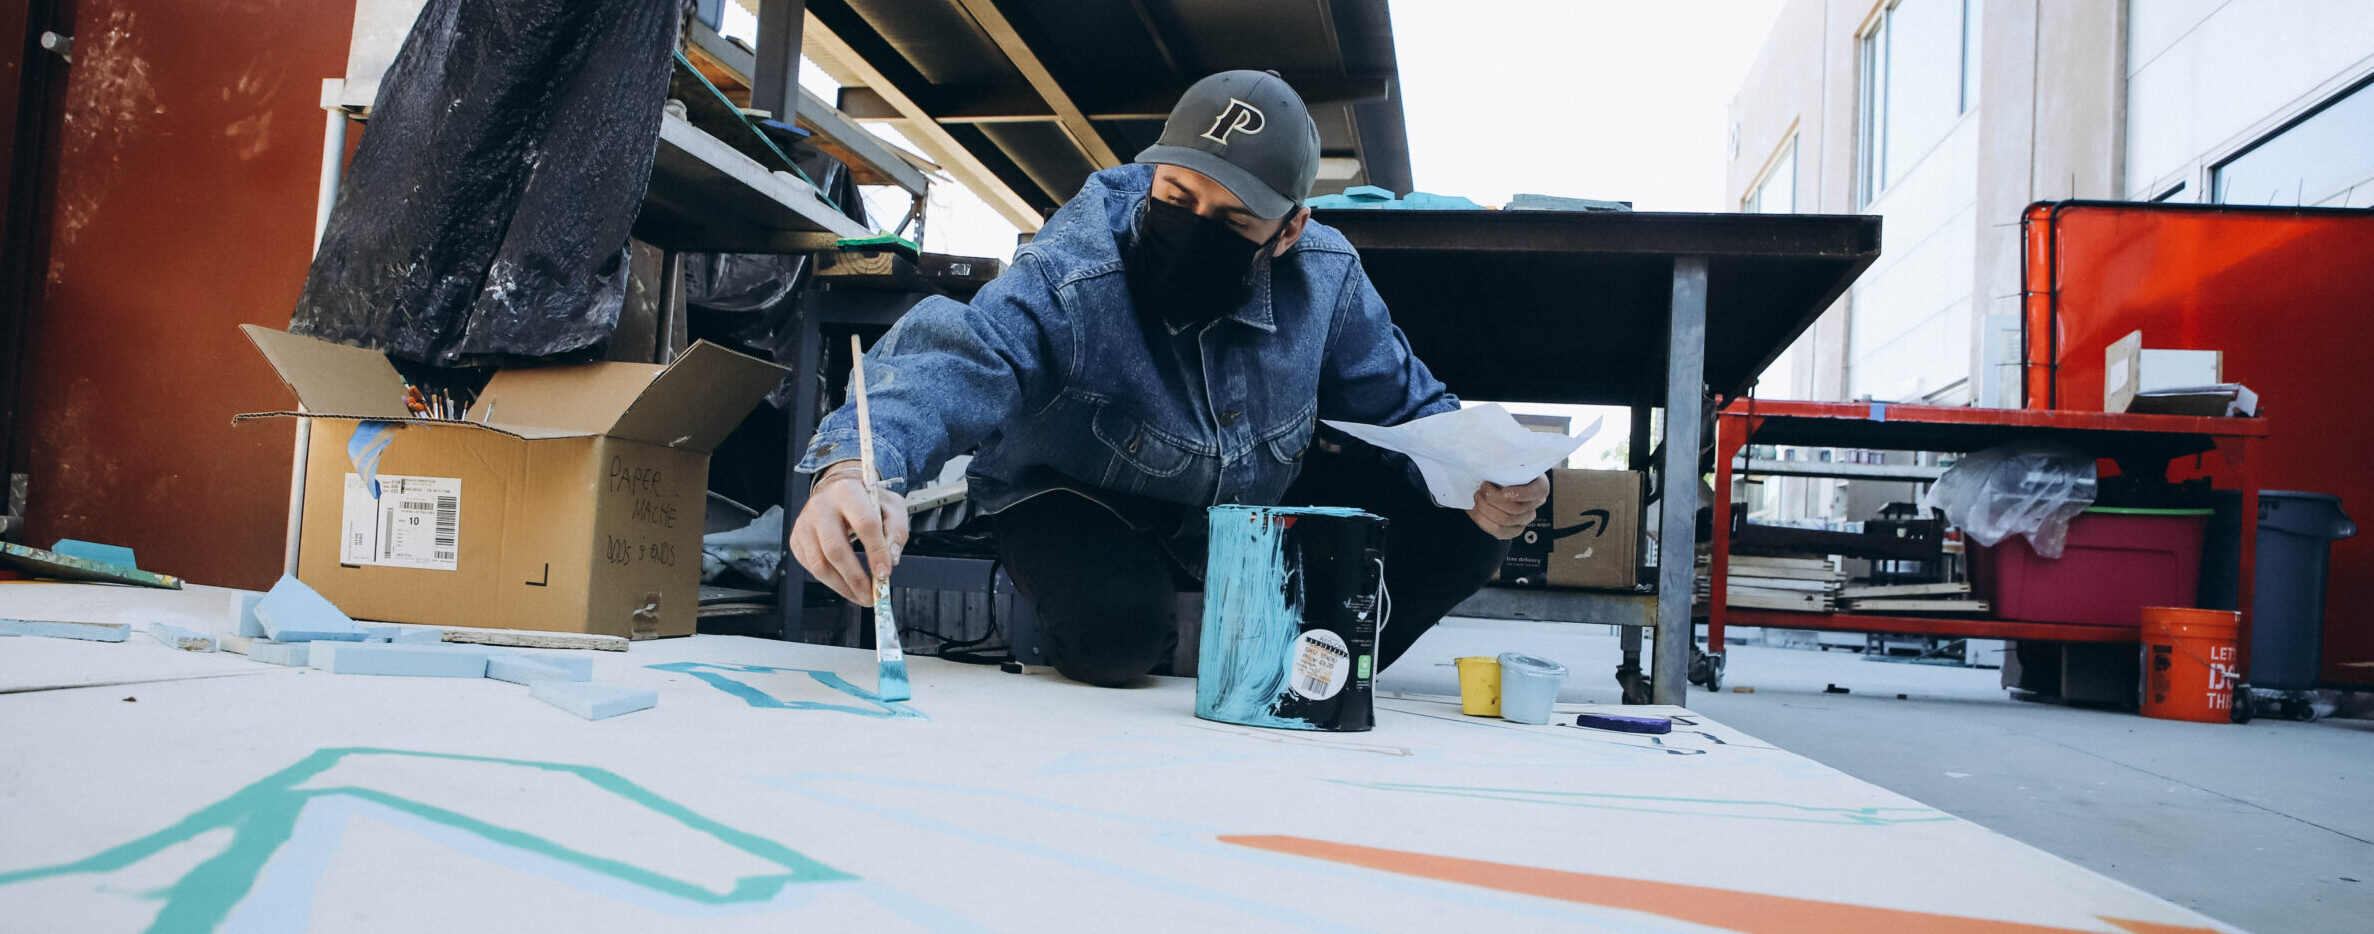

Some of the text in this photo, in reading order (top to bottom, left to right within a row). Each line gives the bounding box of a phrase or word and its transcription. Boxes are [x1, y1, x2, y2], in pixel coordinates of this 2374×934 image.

[1200, 97, 1266, 146] P
[609, 455, 662, 497] PAPER
[409, 517, 420, 526] 10
[631, 499, 677, 529] MACHE
